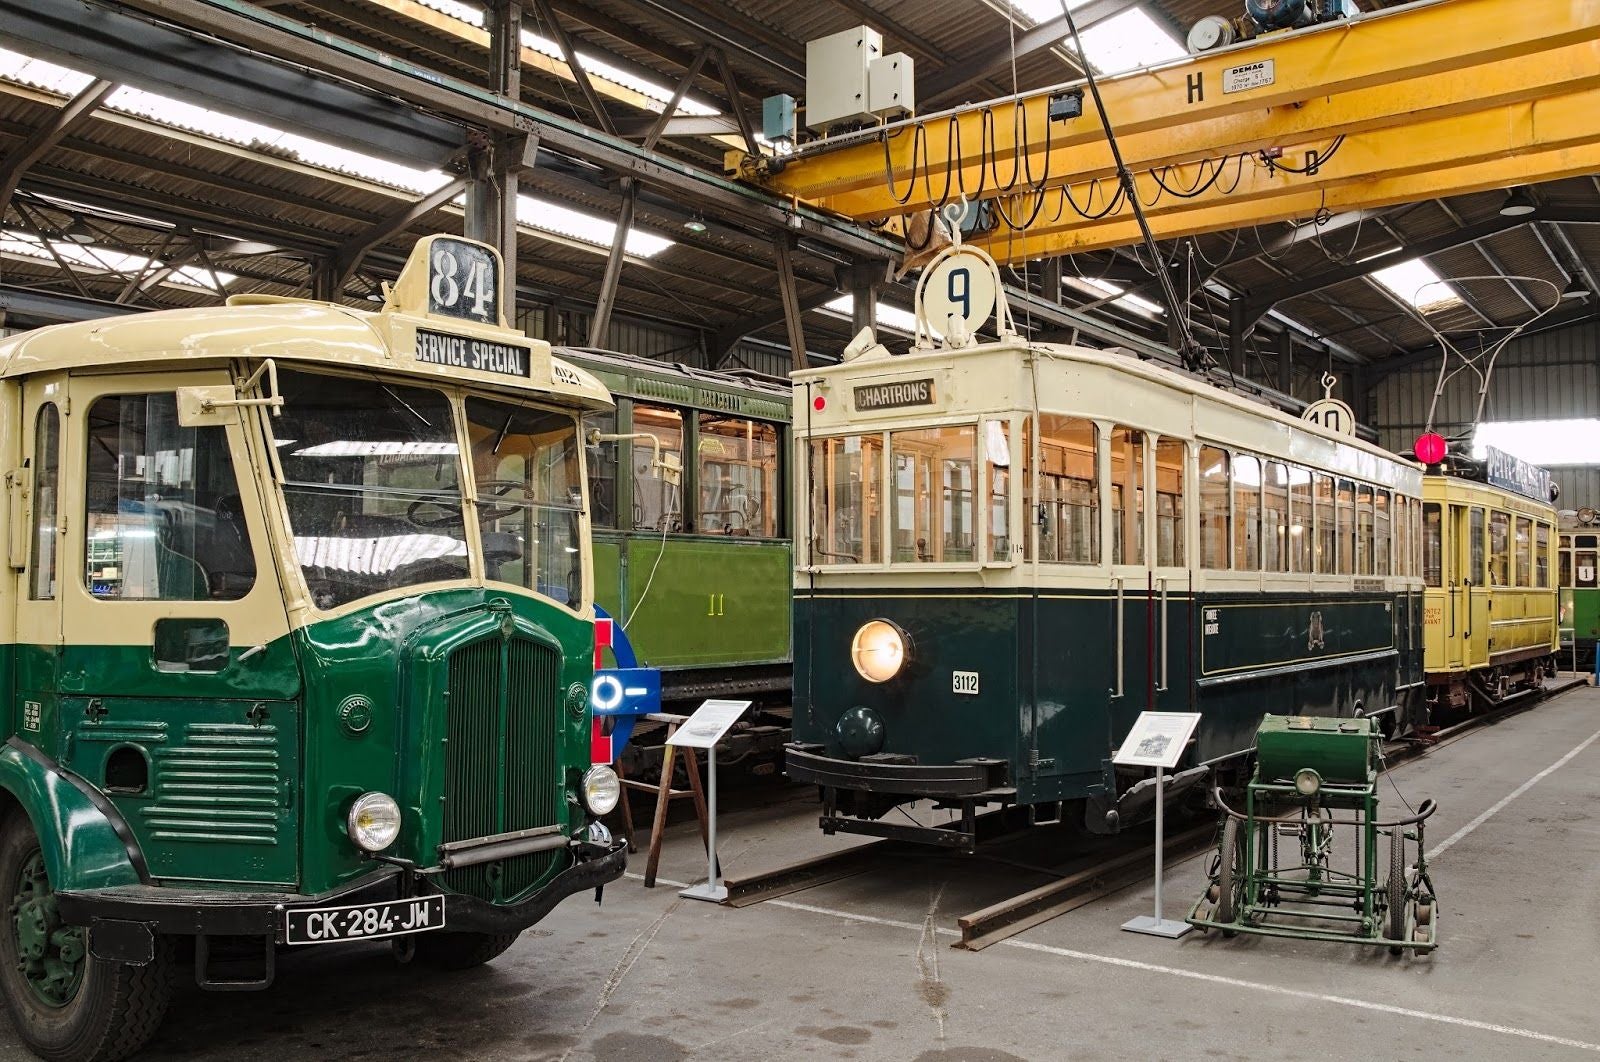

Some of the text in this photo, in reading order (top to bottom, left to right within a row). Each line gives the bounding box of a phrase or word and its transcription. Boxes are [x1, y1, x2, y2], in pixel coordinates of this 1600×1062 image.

[1233, 63, 1264, 74] DEMAG
[1186, 72, 1204, 104] H
[431, 249, 494, 317] 84
[948, 267, 970, 321] 9
[415, 332, 524, 376] SERVICE SPECIAL
[859, 381, 928, 407] CHARTRONS
[1584, 568, 1588, 579] 1
[707, 593, 724, 616] 11
[954, 674, 977, 691] 3112
[306, 901, 429, 940] CK-284-JW
